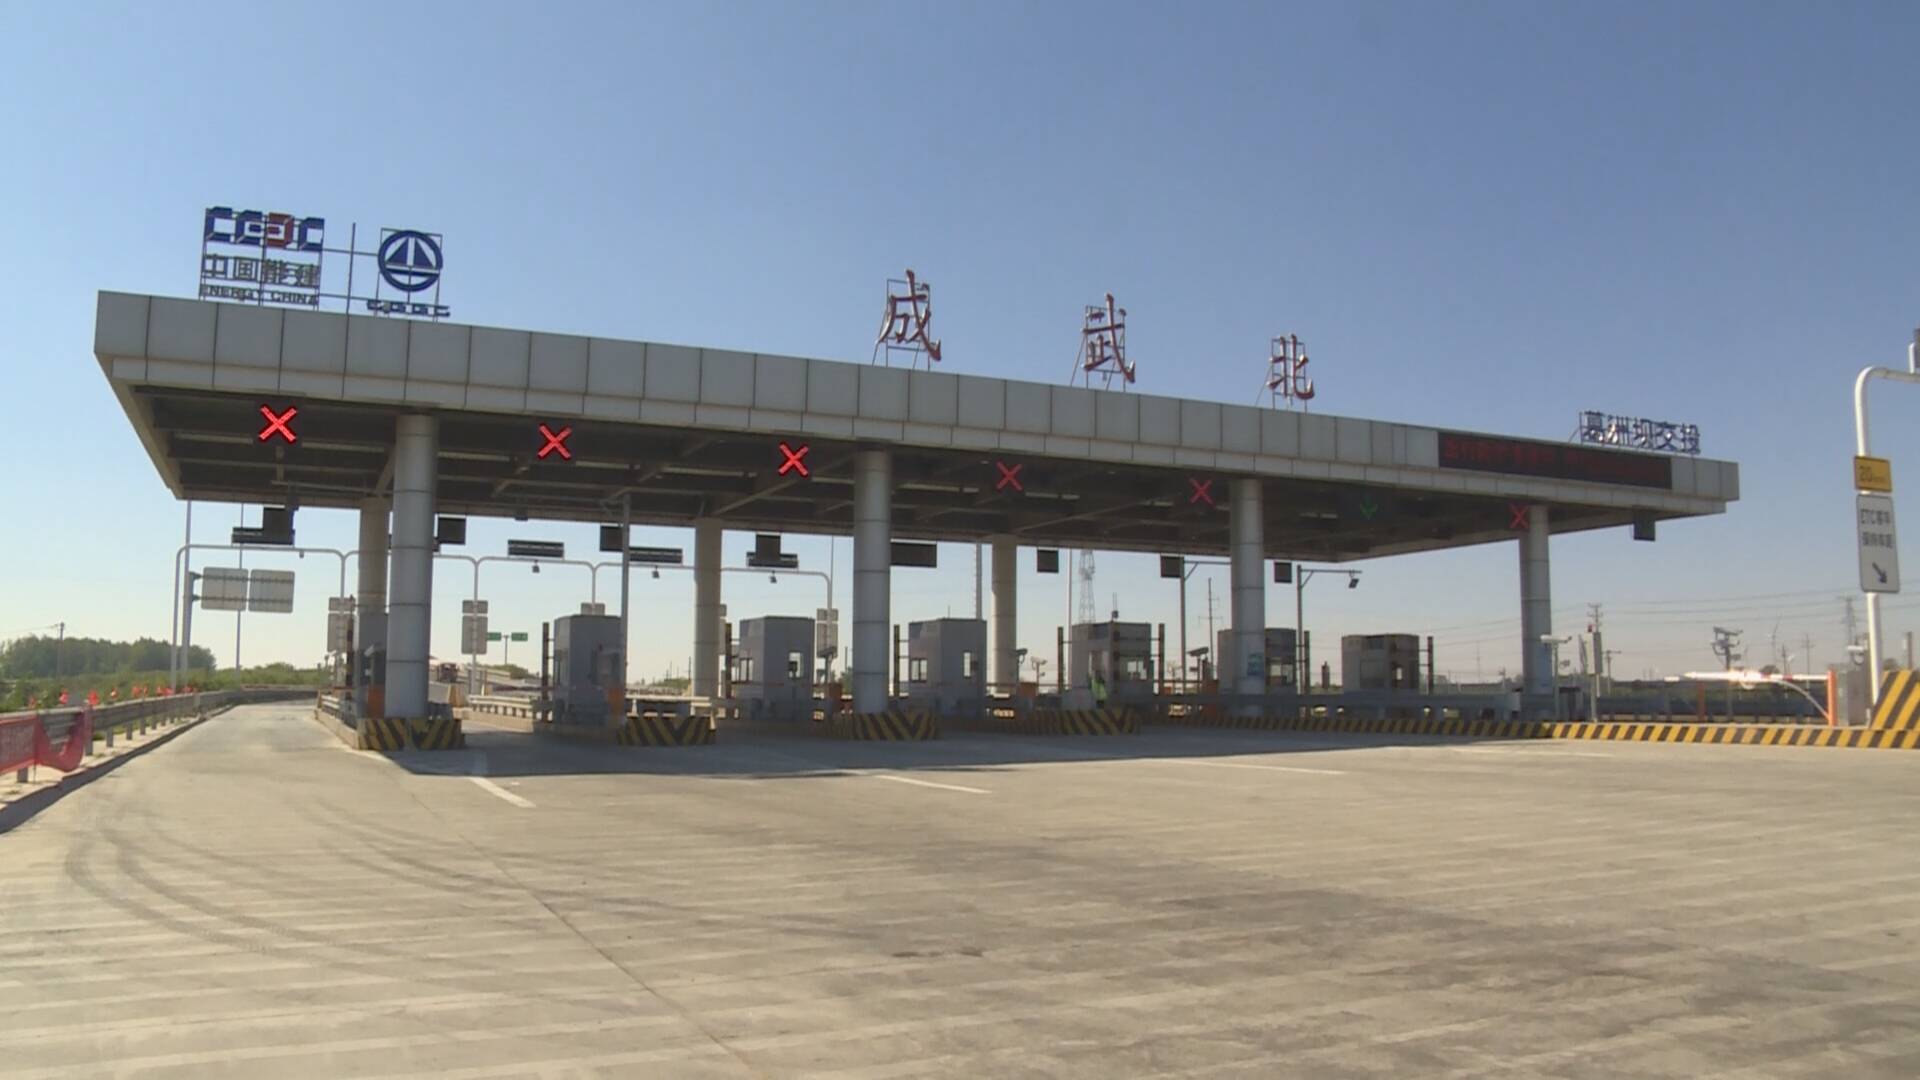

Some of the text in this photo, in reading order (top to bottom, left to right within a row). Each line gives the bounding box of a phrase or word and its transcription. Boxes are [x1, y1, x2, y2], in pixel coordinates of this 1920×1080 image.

[201, 254, 320, 288] 中国能建
[201, 285, 320, 306] ENERGY CHINA
[1582, 411, 1700, 453] 葛洲坝交投
